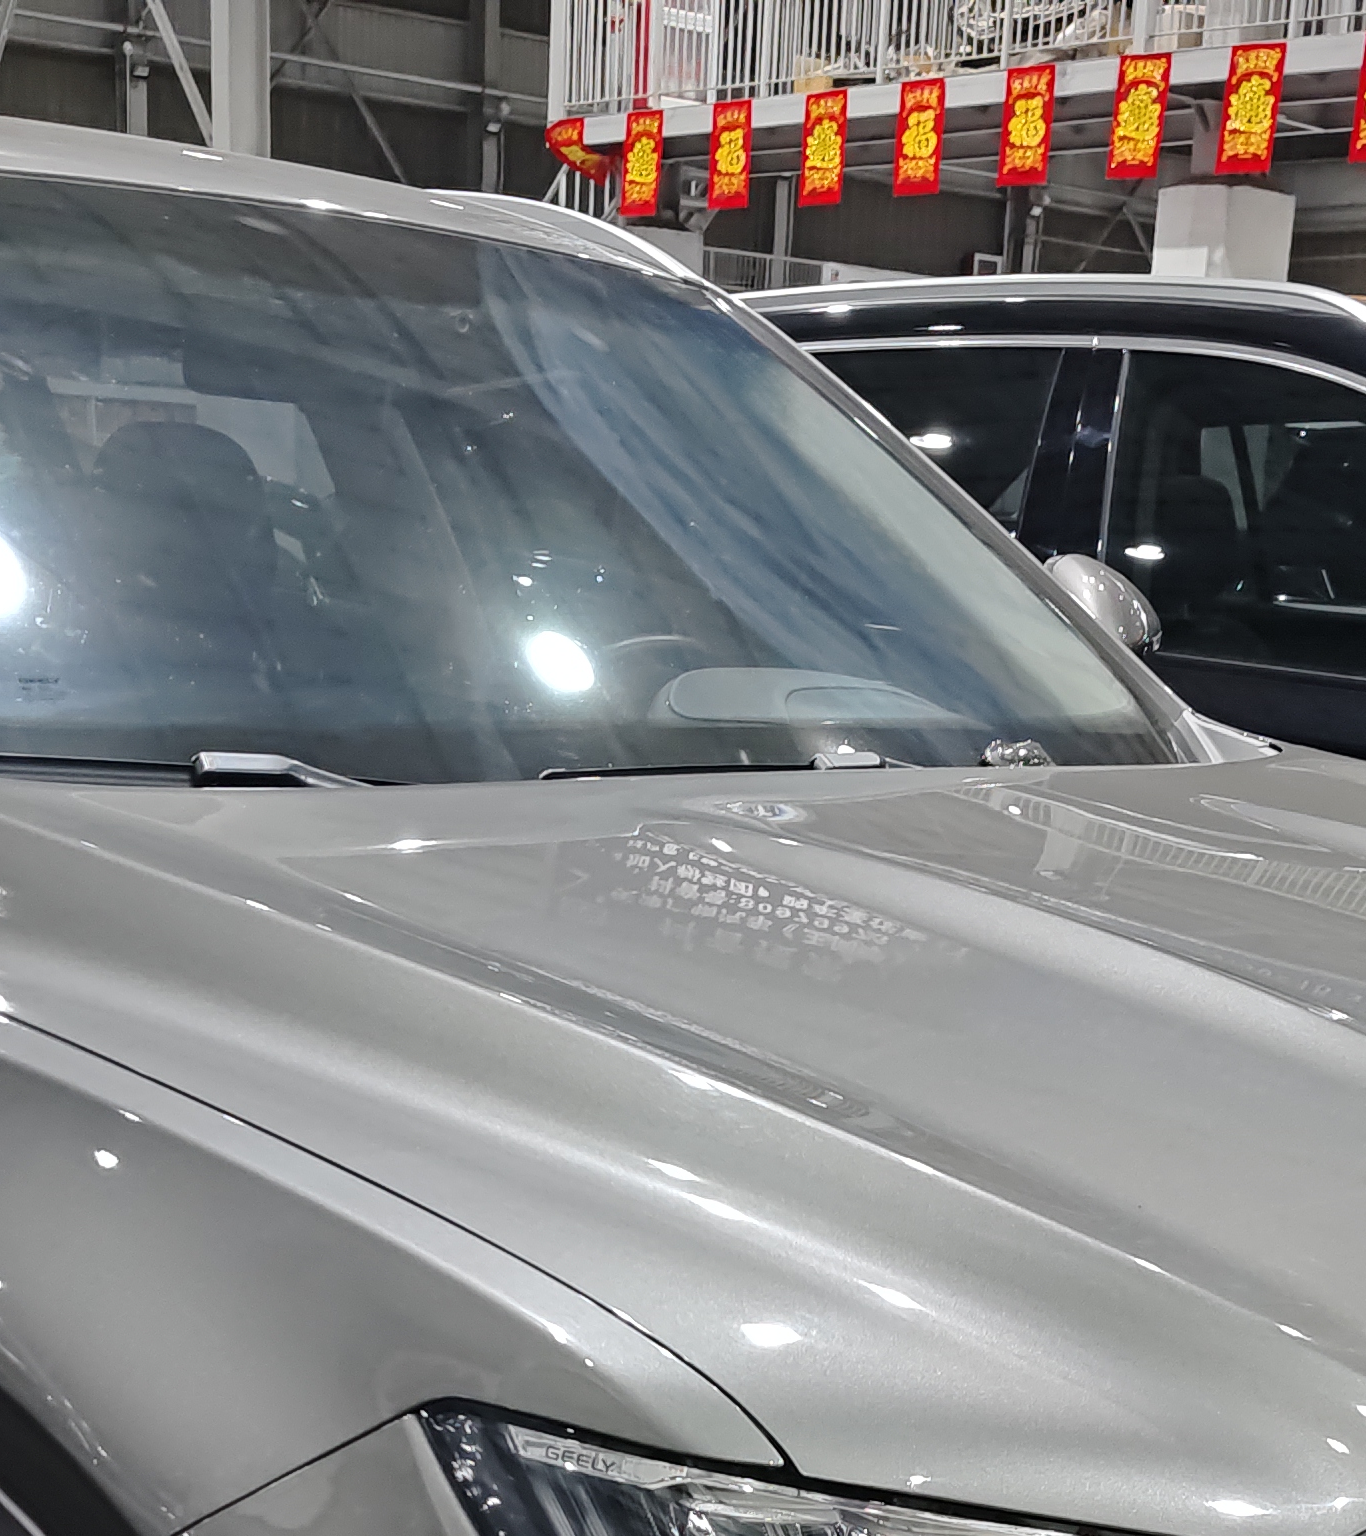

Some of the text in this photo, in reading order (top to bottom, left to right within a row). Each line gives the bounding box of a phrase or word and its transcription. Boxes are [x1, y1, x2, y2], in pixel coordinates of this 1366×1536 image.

[902, 109, 937, 158] 福
[1008, 96, 1046, 147] 福
[715, 128, 746, 174] 福
[545, 1445, 617, 1474] GEELY
